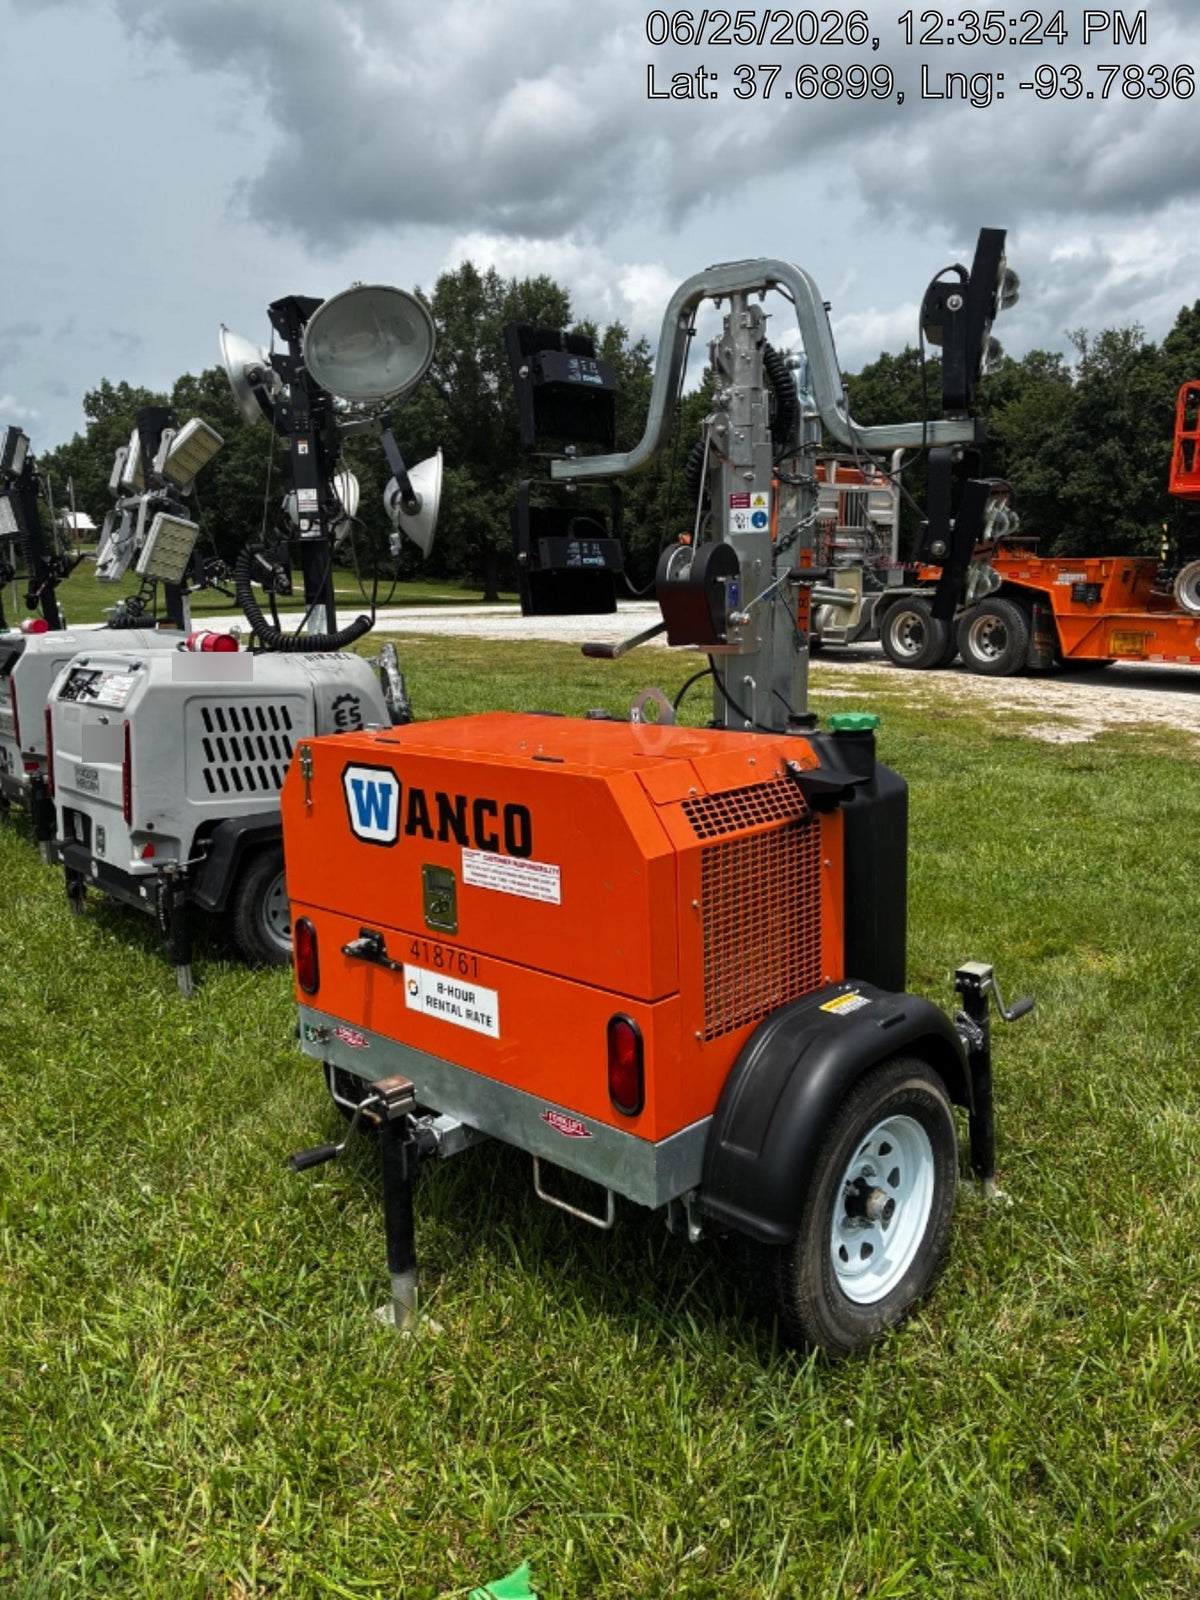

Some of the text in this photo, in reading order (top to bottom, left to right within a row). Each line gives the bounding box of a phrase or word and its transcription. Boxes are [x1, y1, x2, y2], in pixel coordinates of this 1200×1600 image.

[350, 778, 532, 858] WANCO
[410, 940, 477, 978] 418761
[437, 983, 475, 1004] 8-HOUR
[426, 995, 492, 1028] RENTAL RATE
